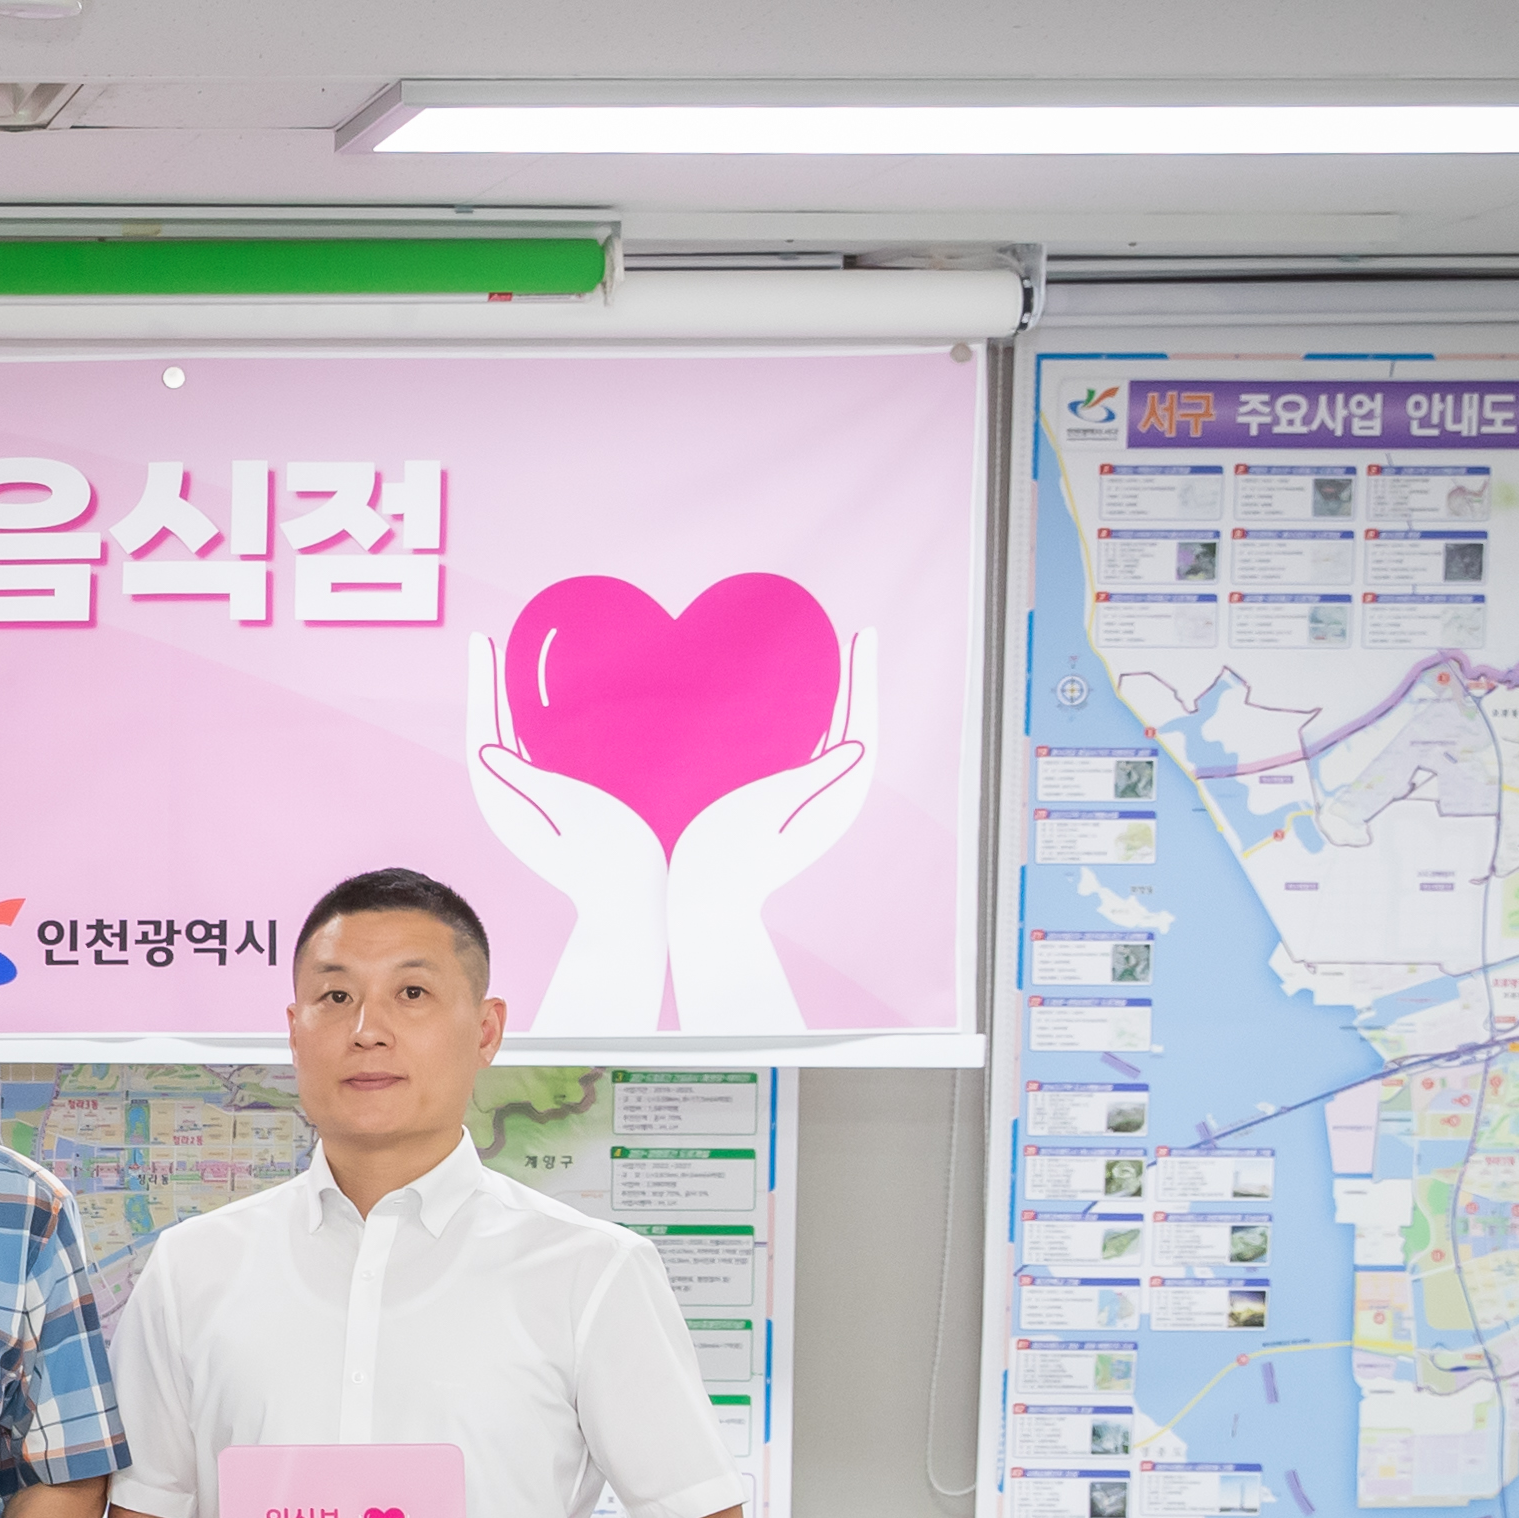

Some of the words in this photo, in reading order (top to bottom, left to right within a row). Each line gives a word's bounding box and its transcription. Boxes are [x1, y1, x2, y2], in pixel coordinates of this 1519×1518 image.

[1138, 391, 1216, 438] 서구
[1236, 392, 1384, 438] 주요사업
[1405, 392, 1518, 438] 안내도
[36, 917, 278, 969] 인천광역시
[613, 1148, 623, 1158] 4
